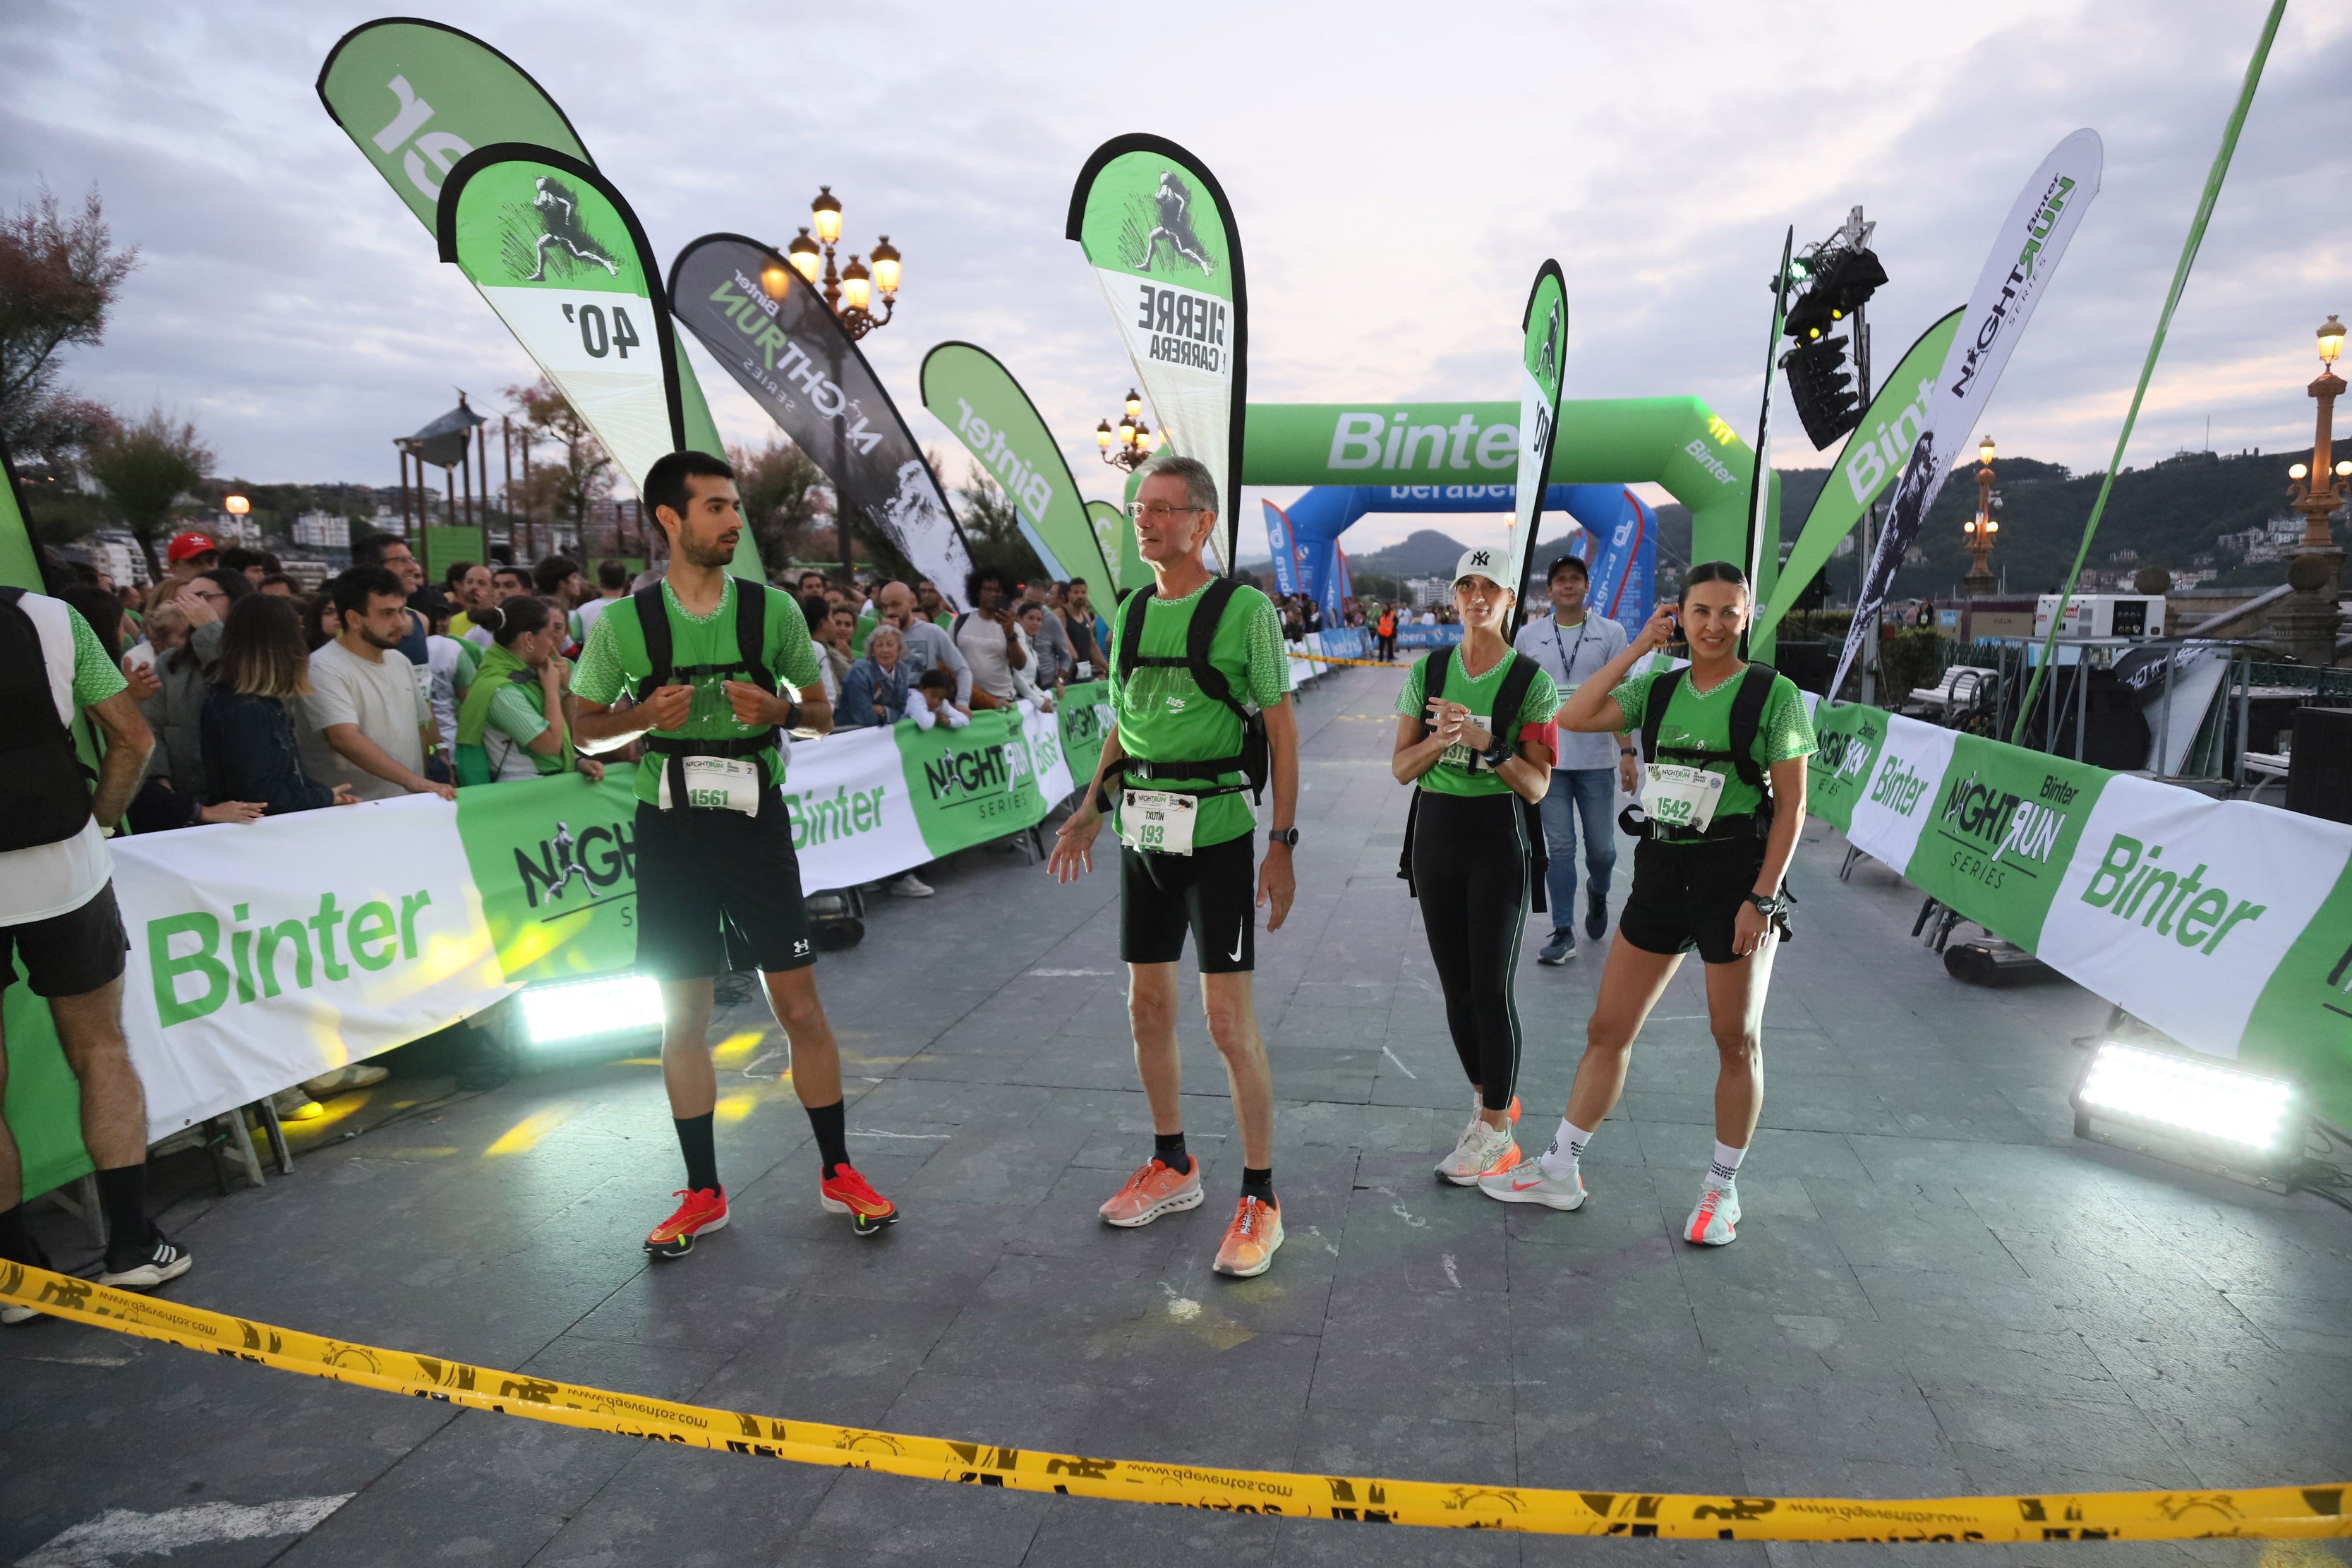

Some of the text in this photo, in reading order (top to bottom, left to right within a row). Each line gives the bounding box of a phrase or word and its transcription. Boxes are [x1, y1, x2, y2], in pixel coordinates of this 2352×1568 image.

[2027, 172, 2058, 234] Binter
[2009, 256, 2046, 327] SERIES
[1684, 438, 1738, 486] Binter
[1166, 696, 1186, 708] 2025
[1444, 743, 1471, 761] 1375
[689, 788, 728, 806] 1561
[1871, 754, 1929, 816] Binter
[2039, 775, 2080, 806] Binter
[781, 785, 885, 850] Binter
[1657, 797, 1691, 819] 1542
[1140, 824, 1164, 844] 193
[1950, 850, 2006, 890] SERIES
[2080, 833, 2268, 956] Binter
[147, 888, 431, 1028] Binter
